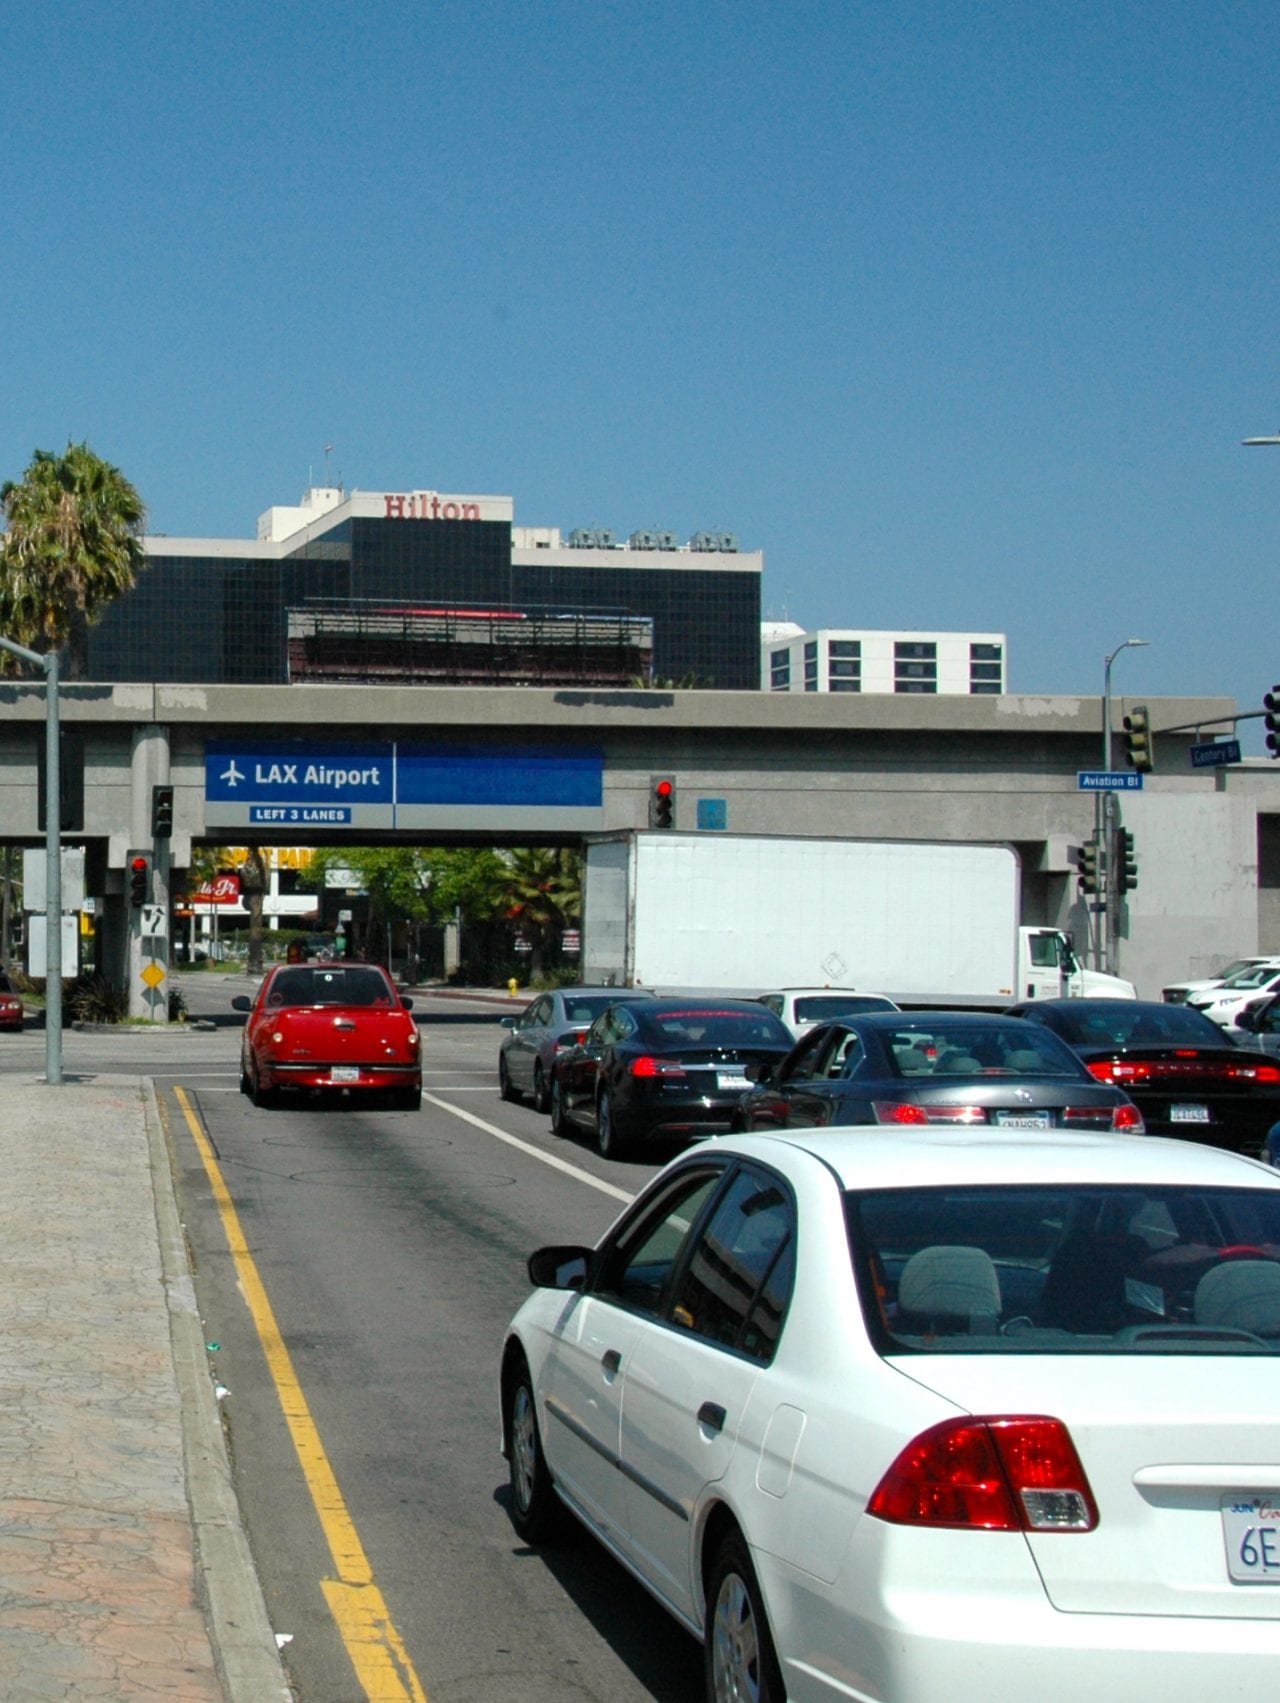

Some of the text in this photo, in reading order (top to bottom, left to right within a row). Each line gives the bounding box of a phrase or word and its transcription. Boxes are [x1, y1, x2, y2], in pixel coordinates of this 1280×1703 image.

[384, 494, 481, 520] Hilton
[255, 764, 380, 789] LAX Airport
[1083, 776, 1124, 786] Aviation
[256, 809, 345, 821] LEFT 3 LANES
[1231, 1503, 1254, 1513] JUN
[1240, 1527, 1280, 1567] 6E
